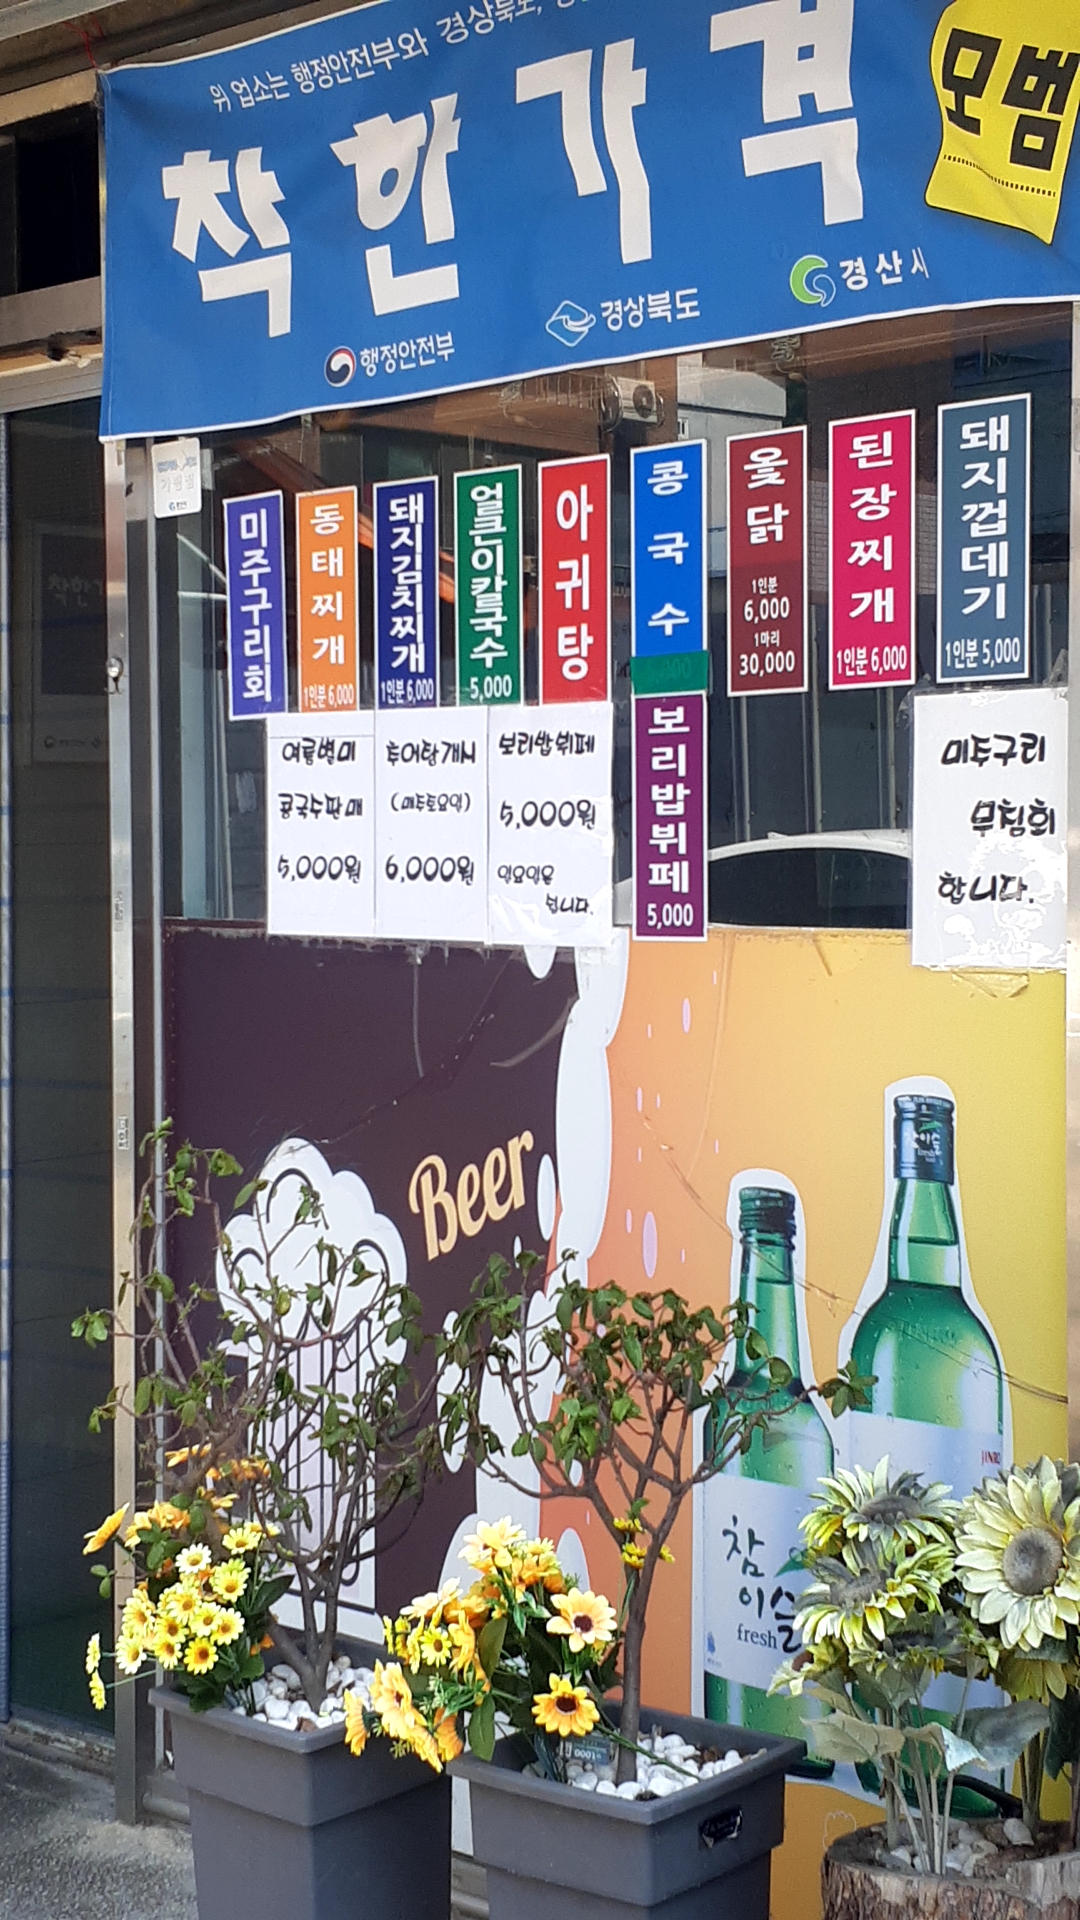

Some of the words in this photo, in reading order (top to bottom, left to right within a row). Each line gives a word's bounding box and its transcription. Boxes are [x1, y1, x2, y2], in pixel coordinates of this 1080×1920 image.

[209, 83, 231, 113] 위
[230, 71, 290, 109] 업소는
[290, 29, 429, 94] 행정안전부와
[941, 28, 1080, 172] 모범
[839, 247, 930, 292] 경산시
[600, 288, 701, 332] 경상북도
[360, 332, 456, 378] 행정안전부
[743, 446, 790, 545] 옻닭
[847, 430, 898, 624] 된장찌개
[959, 414, 1011, 620] 돼지껍데기
[646, 460, 690, 637] 콩국수
[309, 503, 346, 666] 동태찌개
[388, 492, 426, 674] 돼지김치찌개
[468, 482, 509, 669] 얼큰이칼국수
[555, 484, 594, 682] 아귀탕
[751, 576, 779, 595] 1인분
[239, 507, 274, 703] 미주구리회
[743, 596, 790, 624] 6,000
[753, 629, 780, 648] 1마리
[945, 638, 979, 669] 1인분
[982, 637, 1022, 668] 5,000
[739, 650, 795, 678] 30,000
[836, 646, 868, 677] 1인분
[870, 645, 908, 673] 6,000
[303, 684, 327, 709] 1인분
[327, 683, 355, 709] 6,000
[380, 679, 405, 704] 1인분
[406, 678, 435, 706] 6,000
[469, 674, 513, 703] 5,000
[499, 799, 597, 831] 5,000원
[647, 706, 691, 895] 보리밥뷔페
[969, 797, 1056, 838] 무침회
[277, 854, 362, 885] 5,000원
[385, 854, 475, 887] 6,000원
[937, 869, 1035, 906] 합니다.
[646, 902, 695, 930] 5,000
[408, 1130, 535, 1262] Beer
[737, 1622, 778, 1650] fresh
